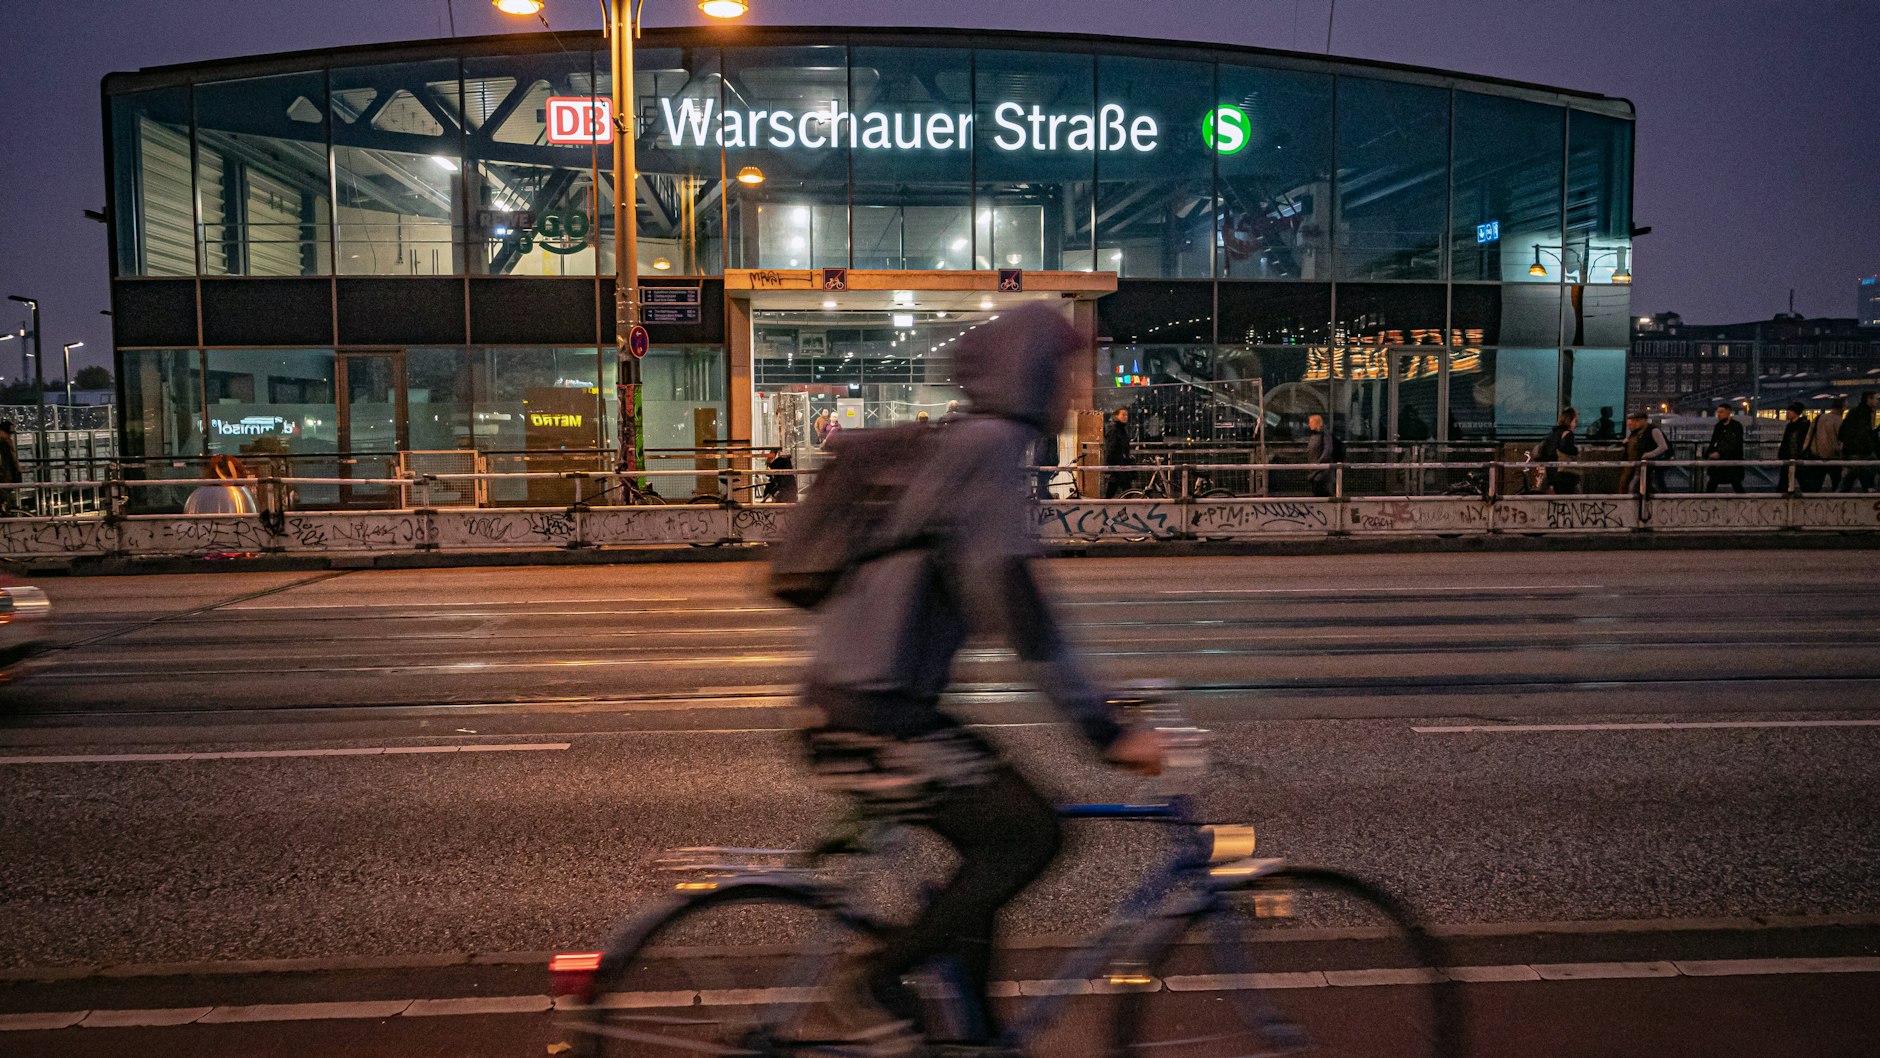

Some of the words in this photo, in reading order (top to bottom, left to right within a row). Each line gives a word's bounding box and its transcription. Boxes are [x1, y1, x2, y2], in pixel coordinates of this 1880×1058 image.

[556, 106, 605, 136] DB
[661, 97, 972, 149] Warschauer
[993, 101, 1158, 152] Straße
[1209, 107, 1244, 151] S
